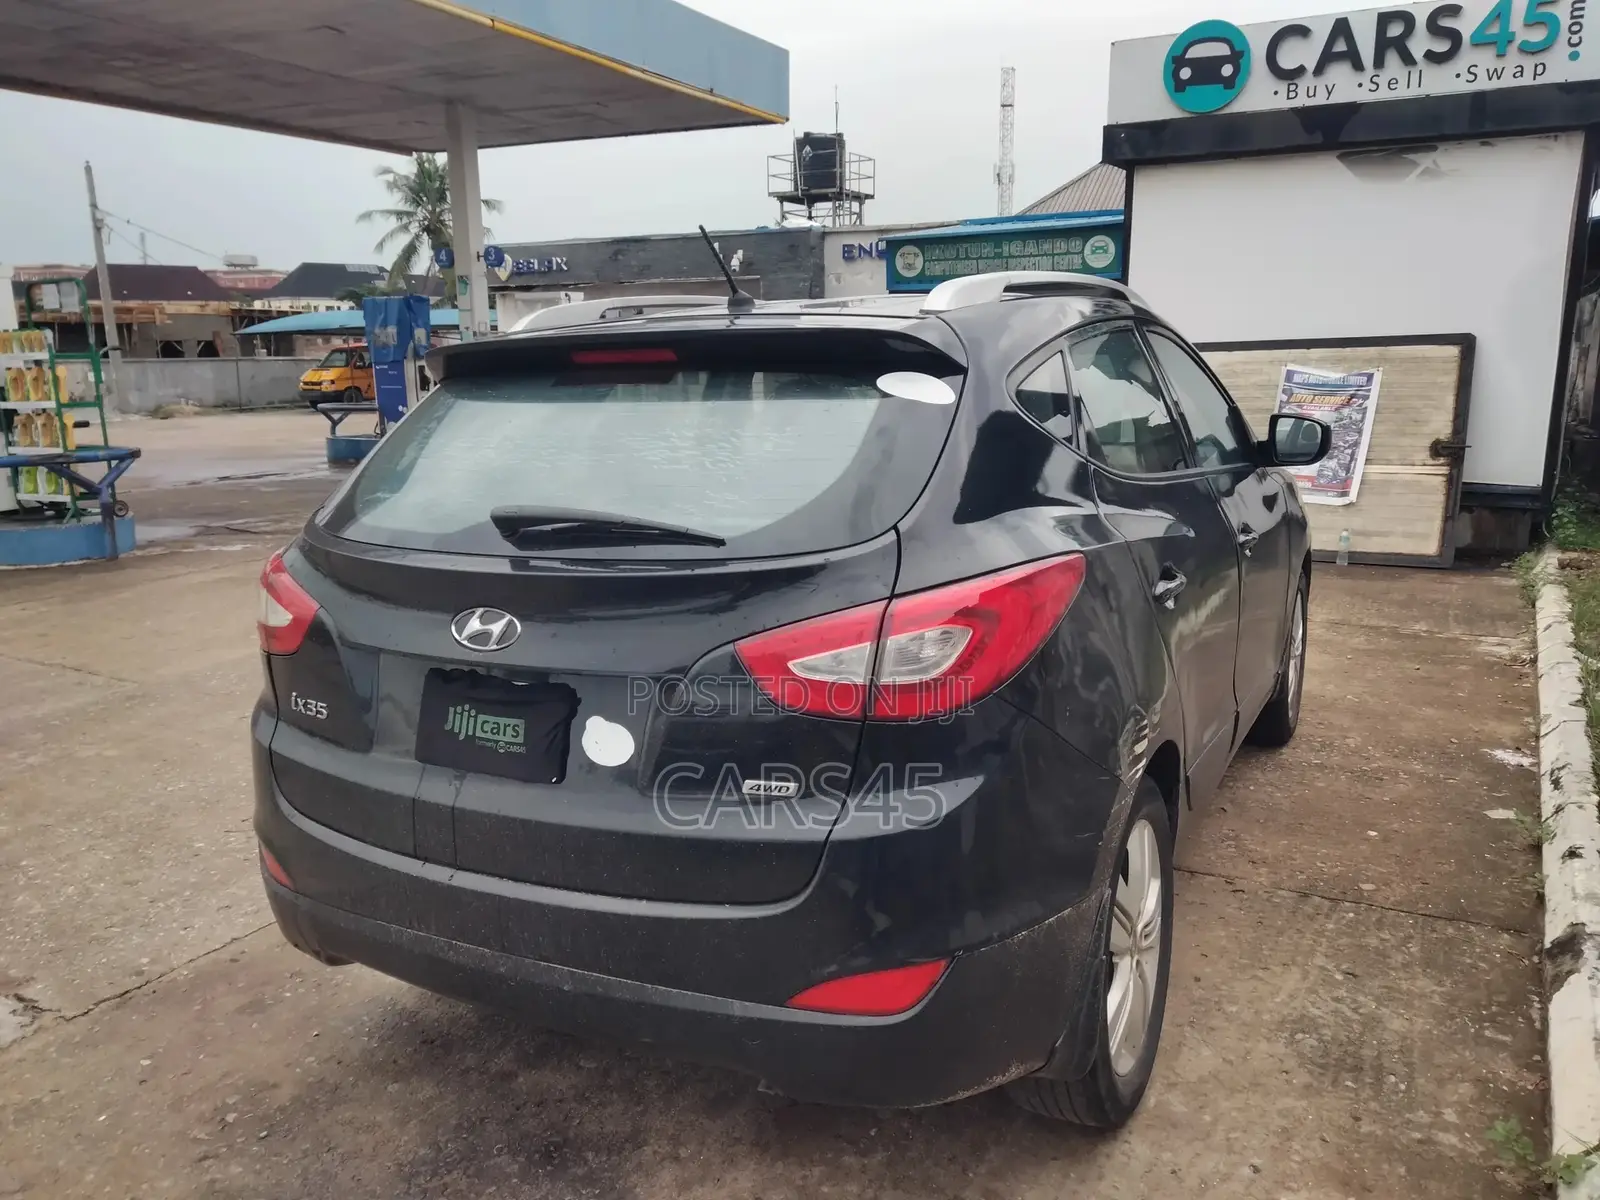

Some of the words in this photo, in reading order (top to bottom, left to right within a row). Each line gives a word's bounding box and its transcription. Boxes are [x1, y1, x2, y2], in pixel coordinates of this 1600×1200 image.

[1265, 0, 1561, 81] CARS45
[439, 249, 447, 261] 4
[488, 247, 496, 261] 3
[925, 237, 1083, 260] IKOTUN-IGANDO
[1290, 393, 1312, 403] AUTO
[1313, 395, 1350, 405] SERVICE
[291, 692, 329, 720] ix35
[747, 783, 792, 795] 4WD
